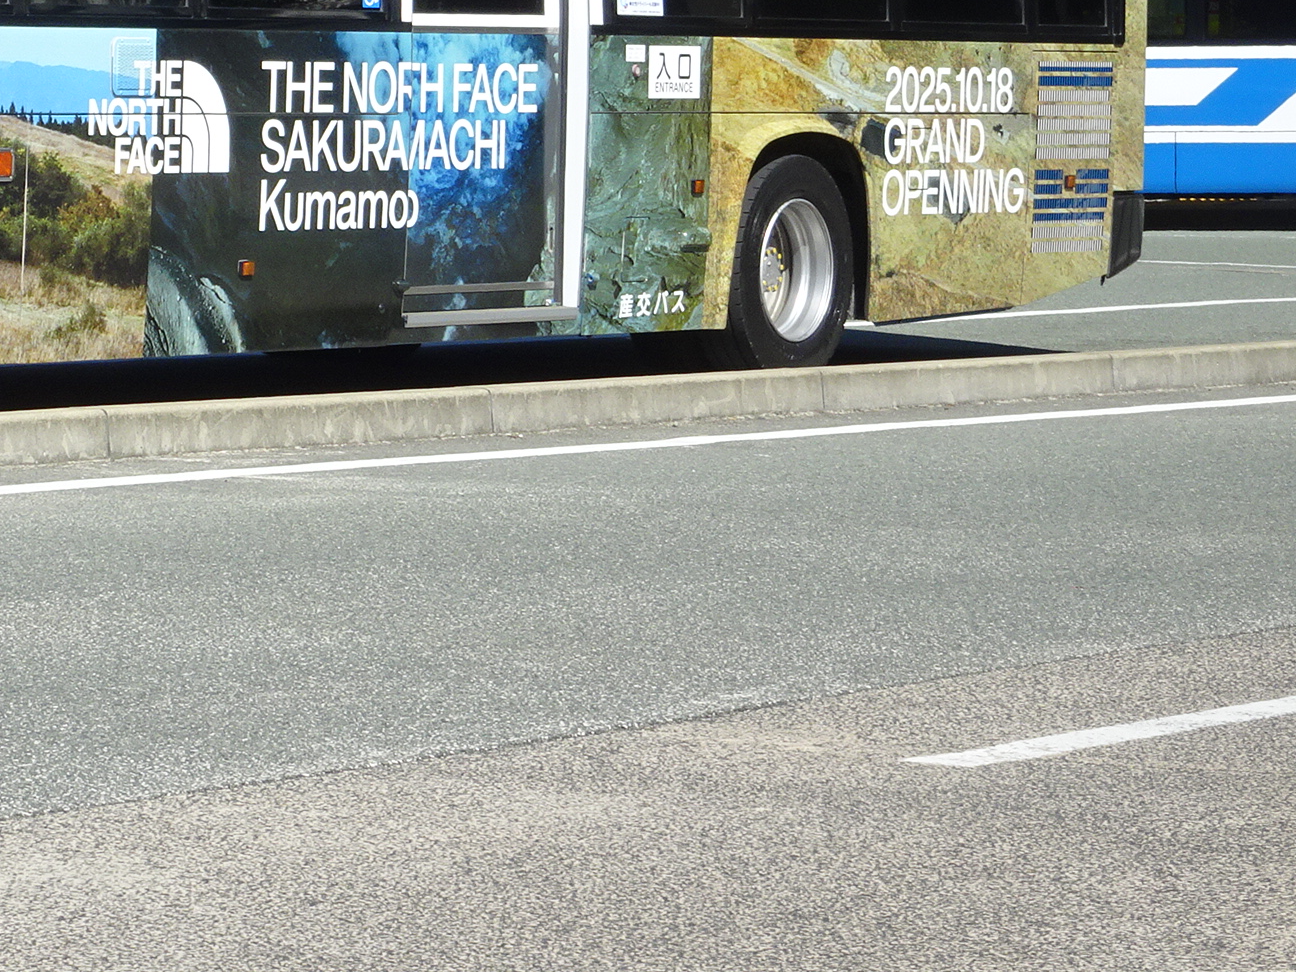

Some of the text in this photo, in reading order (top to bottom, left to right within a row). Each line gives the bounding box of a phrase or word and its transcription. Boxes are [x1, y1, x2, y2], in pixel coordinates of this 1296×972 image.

[134, 60, 182, 97] THE
[656, 52, 692, 80] 入口
[260, 60, 335, 114] THE
[453, 63, 539, 114] FACE
[655, 82, 694, 93] ENTRANCE
[884, 66, 1014, 114] 2025.10.18
[87, 98, 181, 136] NORTH
[114, 136, 181, 175] FACE
[884, 117, 986, 165] GRAND
[881, 167, 1025, 217] OPENNING
[618, 290, 686, 319] 産交バス
